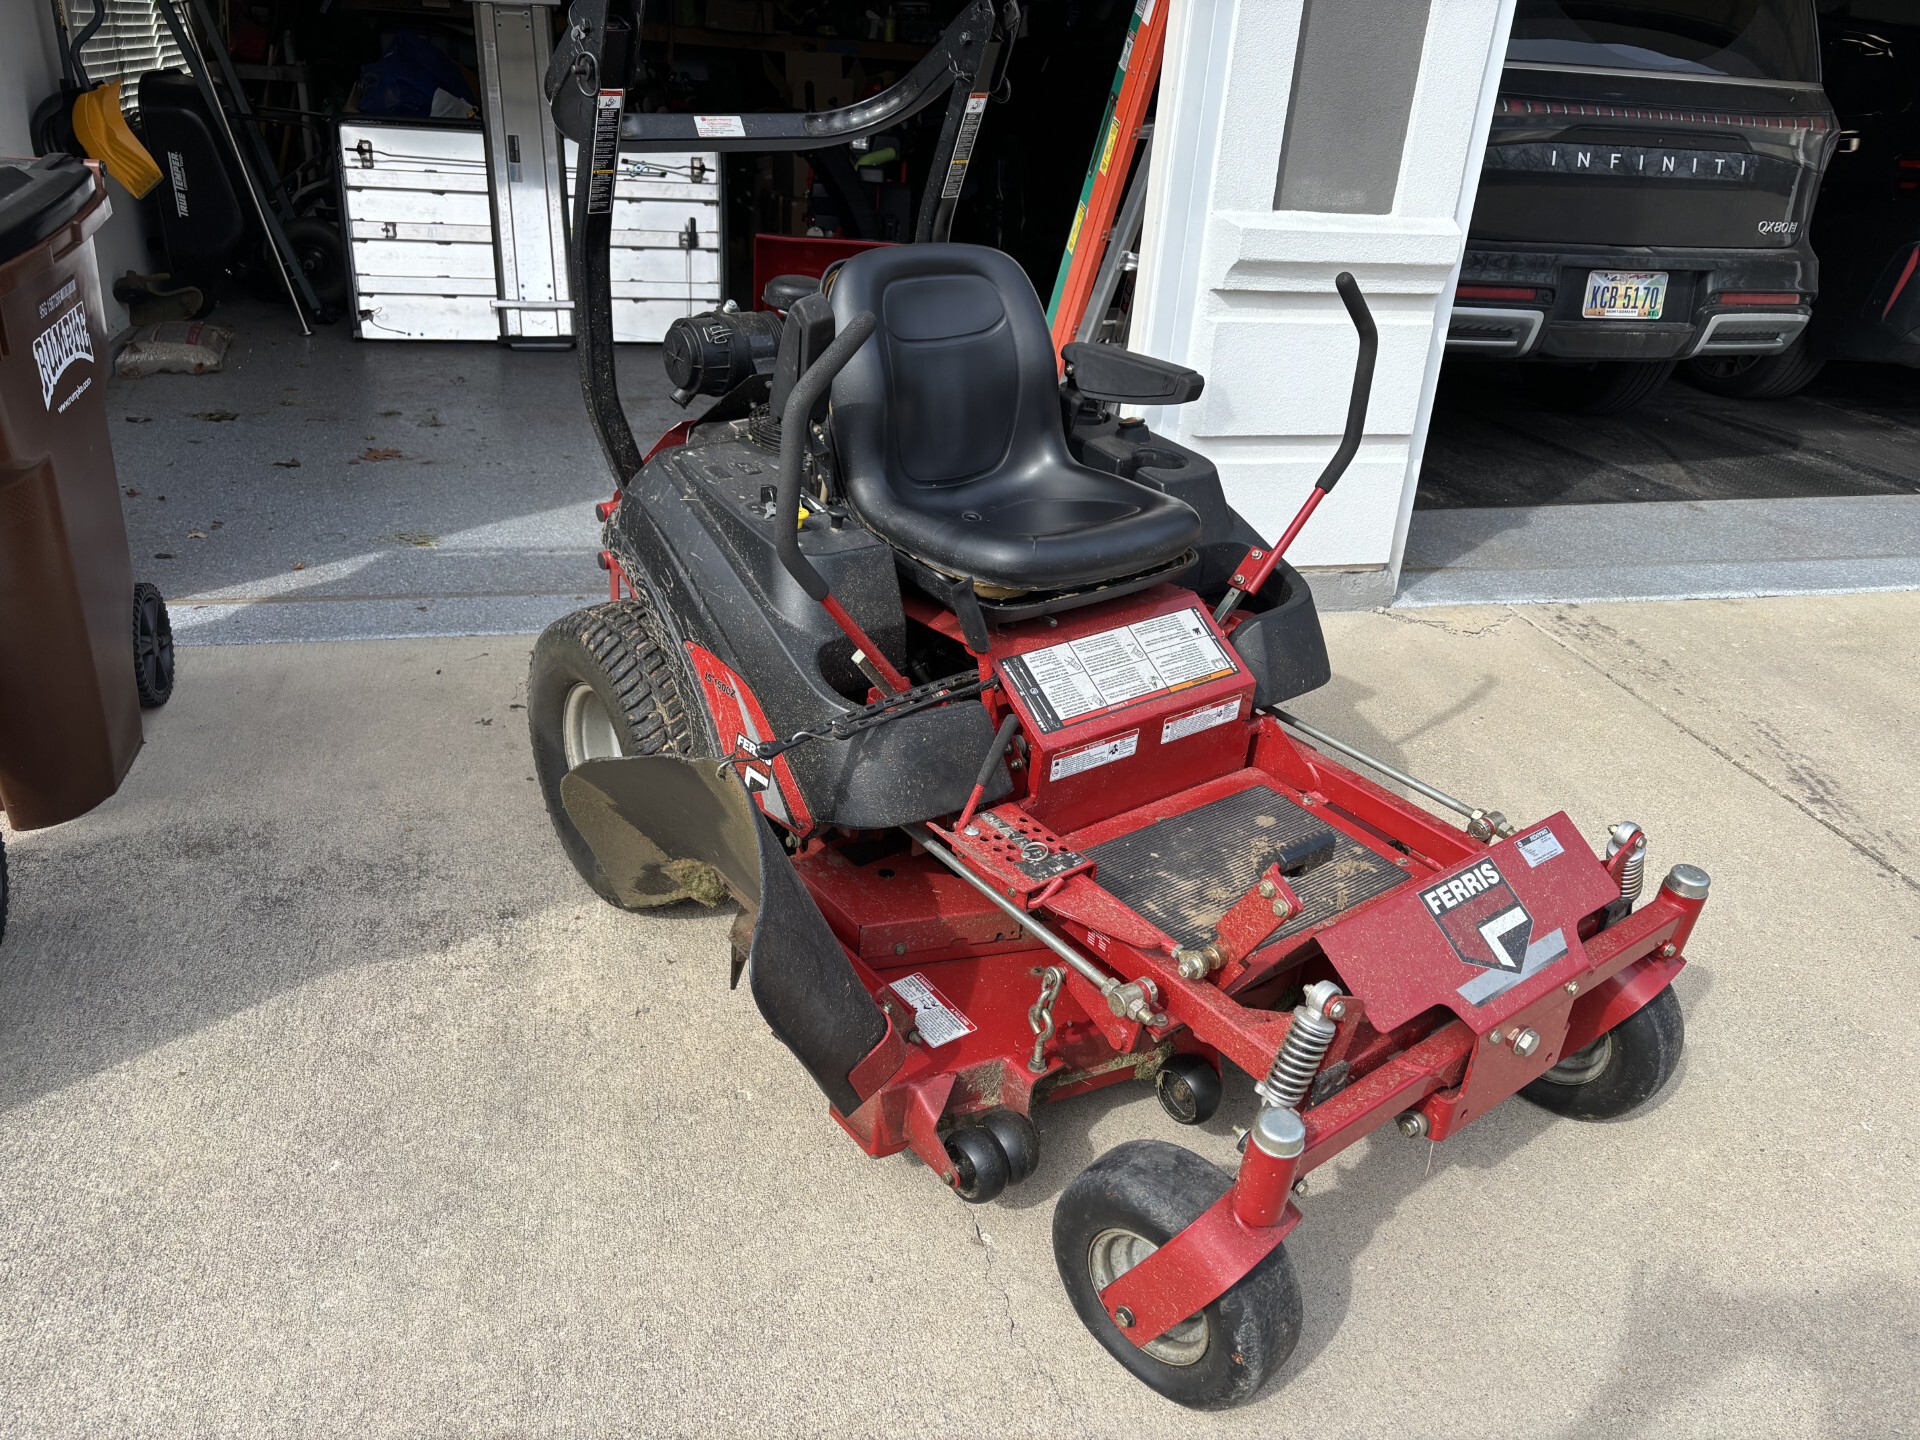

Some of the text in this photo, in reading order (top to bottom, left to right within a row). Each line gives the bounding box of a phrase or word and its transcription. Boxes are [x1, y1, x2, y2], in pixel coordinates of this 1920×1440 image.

[1551, 150, 1747, 176] INFINITI
[174, 192, 189, 218] TRUE
[1590, 285, 1660, 309] KCB 5170
[57, 376, 92, 415] www.rumpke.com
[1424, 863, 1499, 915] FERRIS
[919, 977, 934, 992] DANGER
